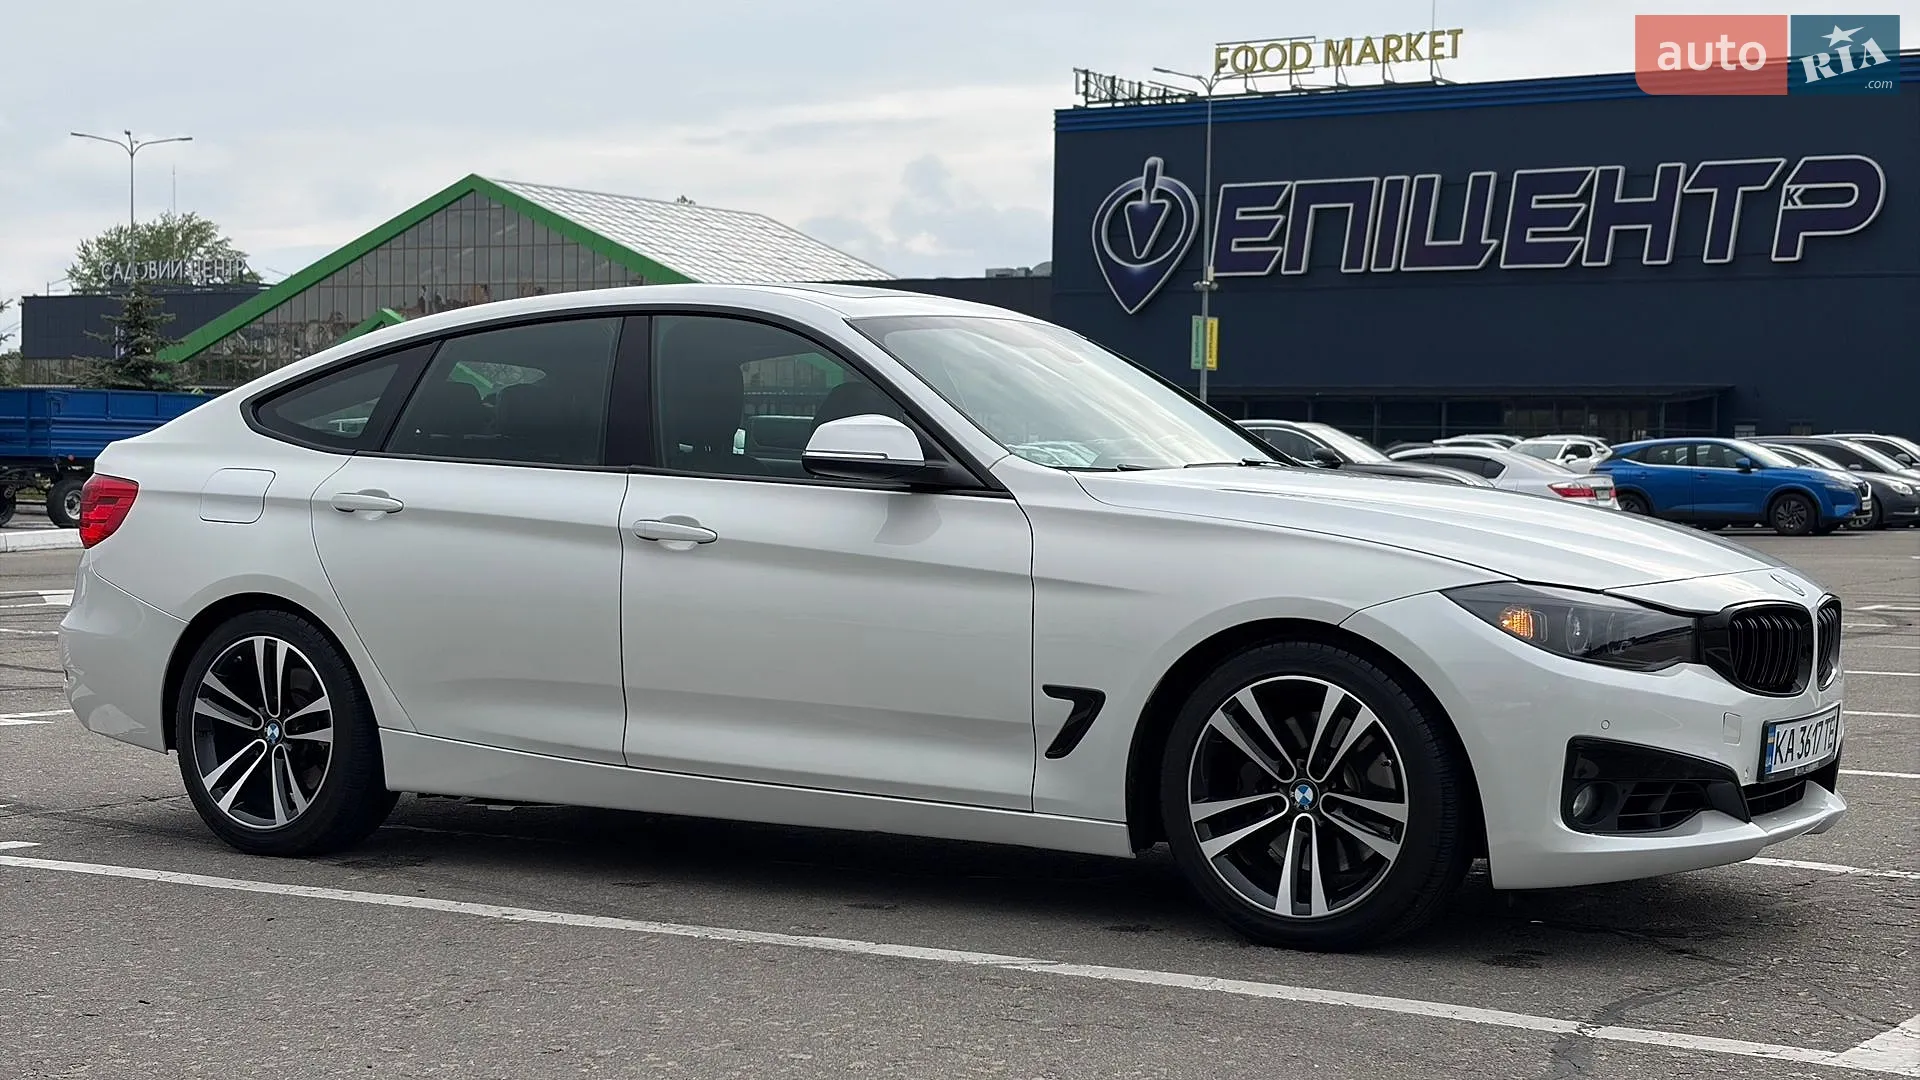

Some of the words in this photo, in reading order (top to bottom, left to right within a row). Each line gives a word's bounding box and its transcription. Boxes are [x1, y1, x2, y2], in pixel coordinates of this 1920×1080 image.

[1214, 40, 1313, 76] FOOD
[1324, 28, 1464, 68] MARKET
[1210, 154, 1886, 276] ЕПІЦЕНТР
[191, 257, 246, 282] ЦЕНТР
[1797, 721, 1824, 759] 3617
